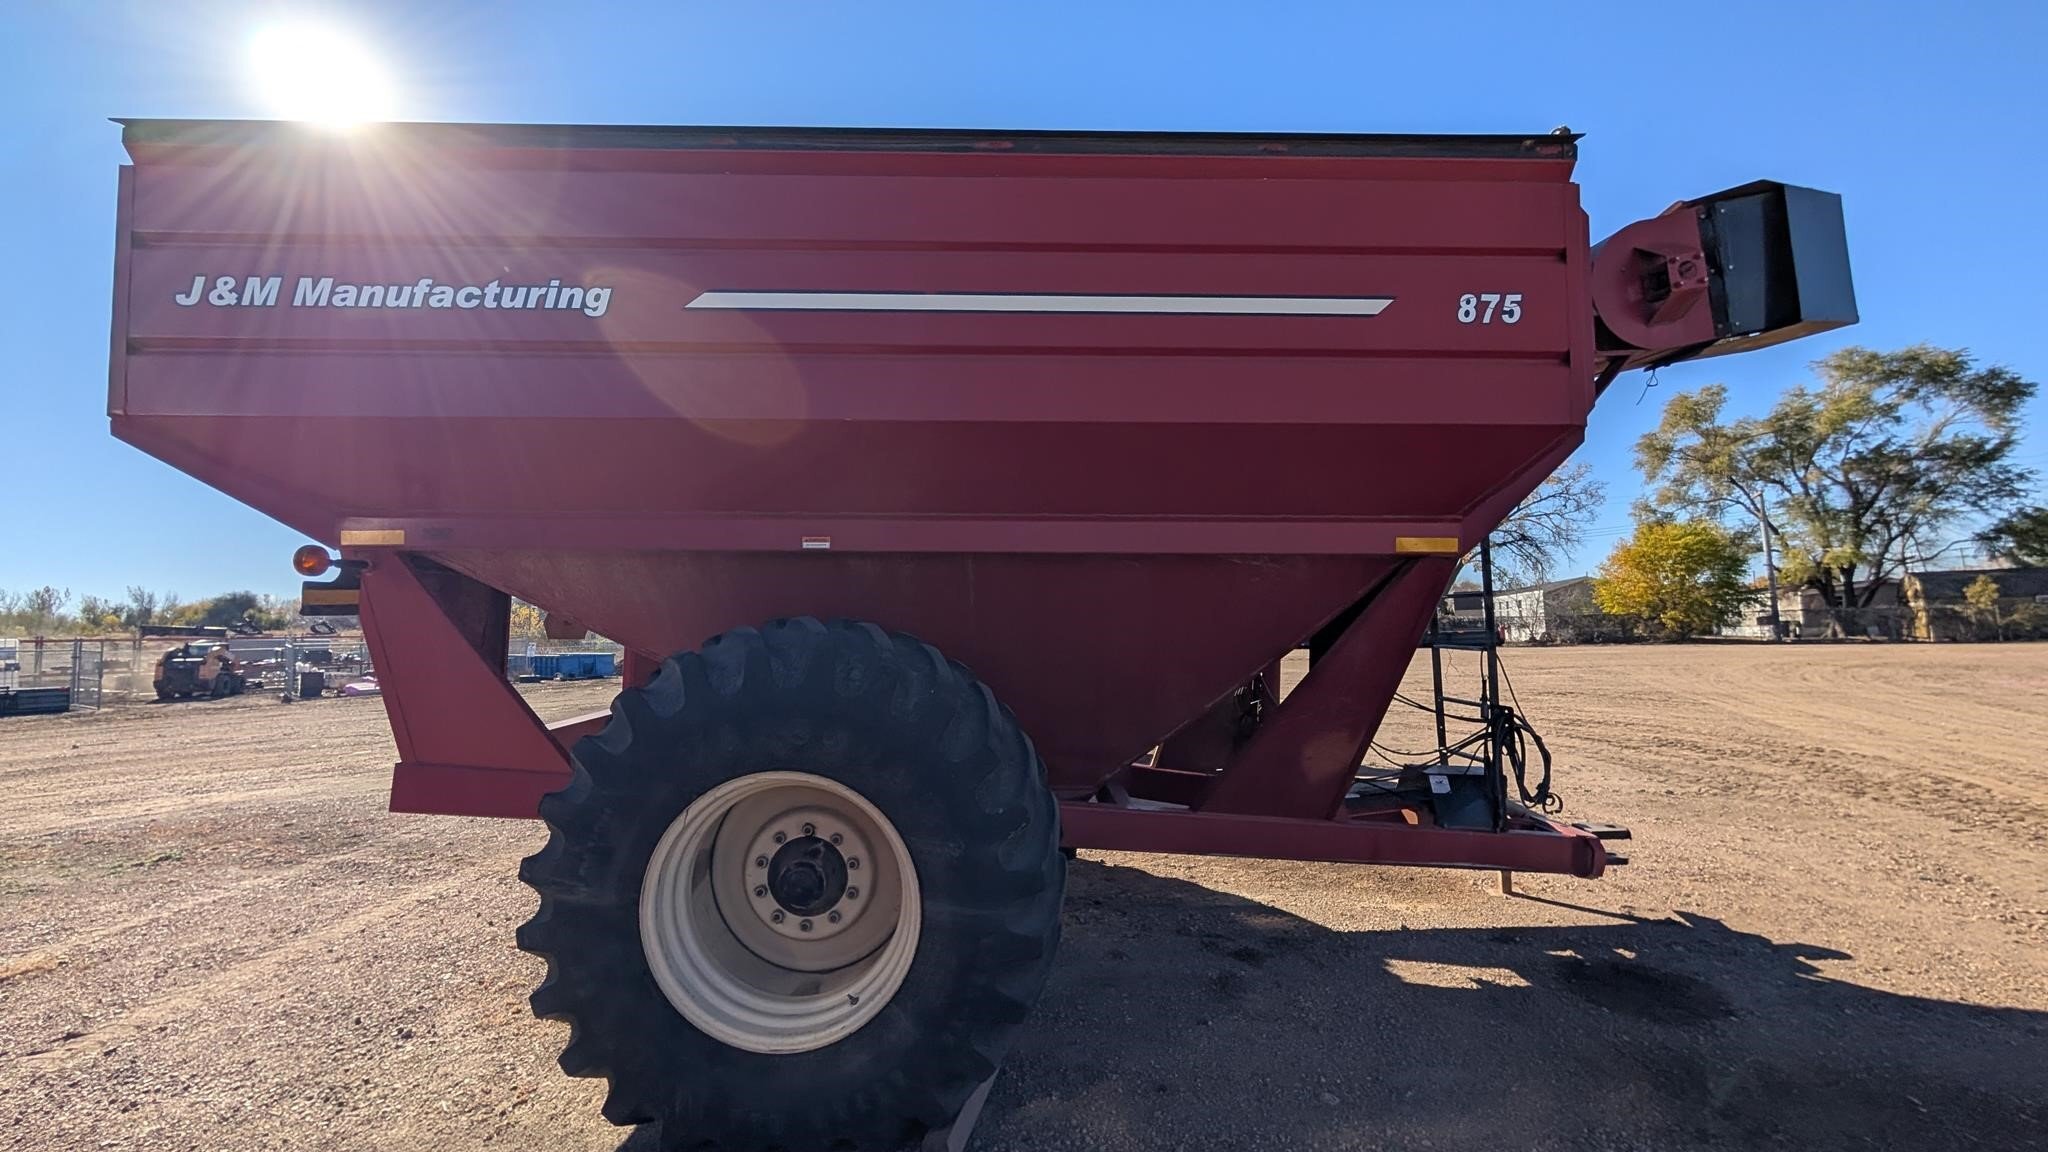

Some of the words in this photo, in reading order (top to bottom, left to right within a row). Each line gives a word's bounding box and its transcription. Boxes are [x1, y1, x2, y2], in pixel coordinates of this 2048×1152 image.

[175, 276, 282, 306] J&M
[292, 277, 612, 317] Manufacturing
[1457, 293, 1523, 324] 875
